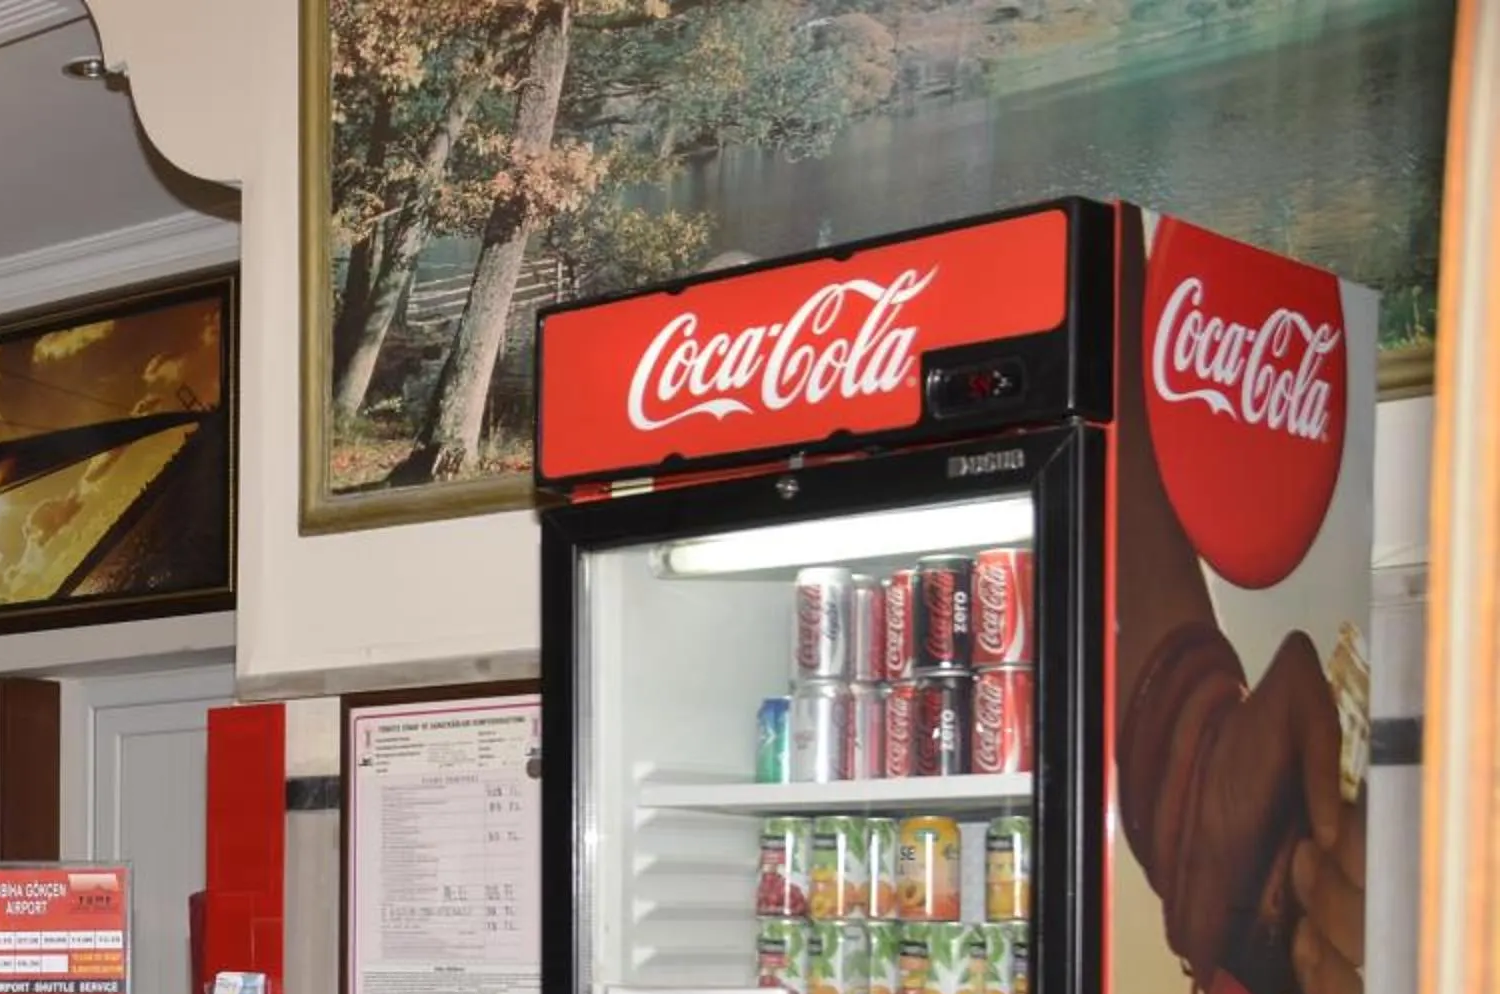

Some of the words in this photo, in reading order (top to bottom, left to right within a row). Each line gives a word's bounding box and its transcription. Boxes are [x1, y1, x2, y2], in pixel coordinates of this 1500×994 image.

[627, 263, 939, 432] Coca-Cola
[1152, 276, 1342, 443] Coca-Cola
[953, 591, 967, 633] zero
[941, 709, 955, 751] zero
[5, 901, 48, 915] AIRPORT
[35, 981, 75, 993] SHUTTLE
[79, 981, 119, 993] SERVICE
